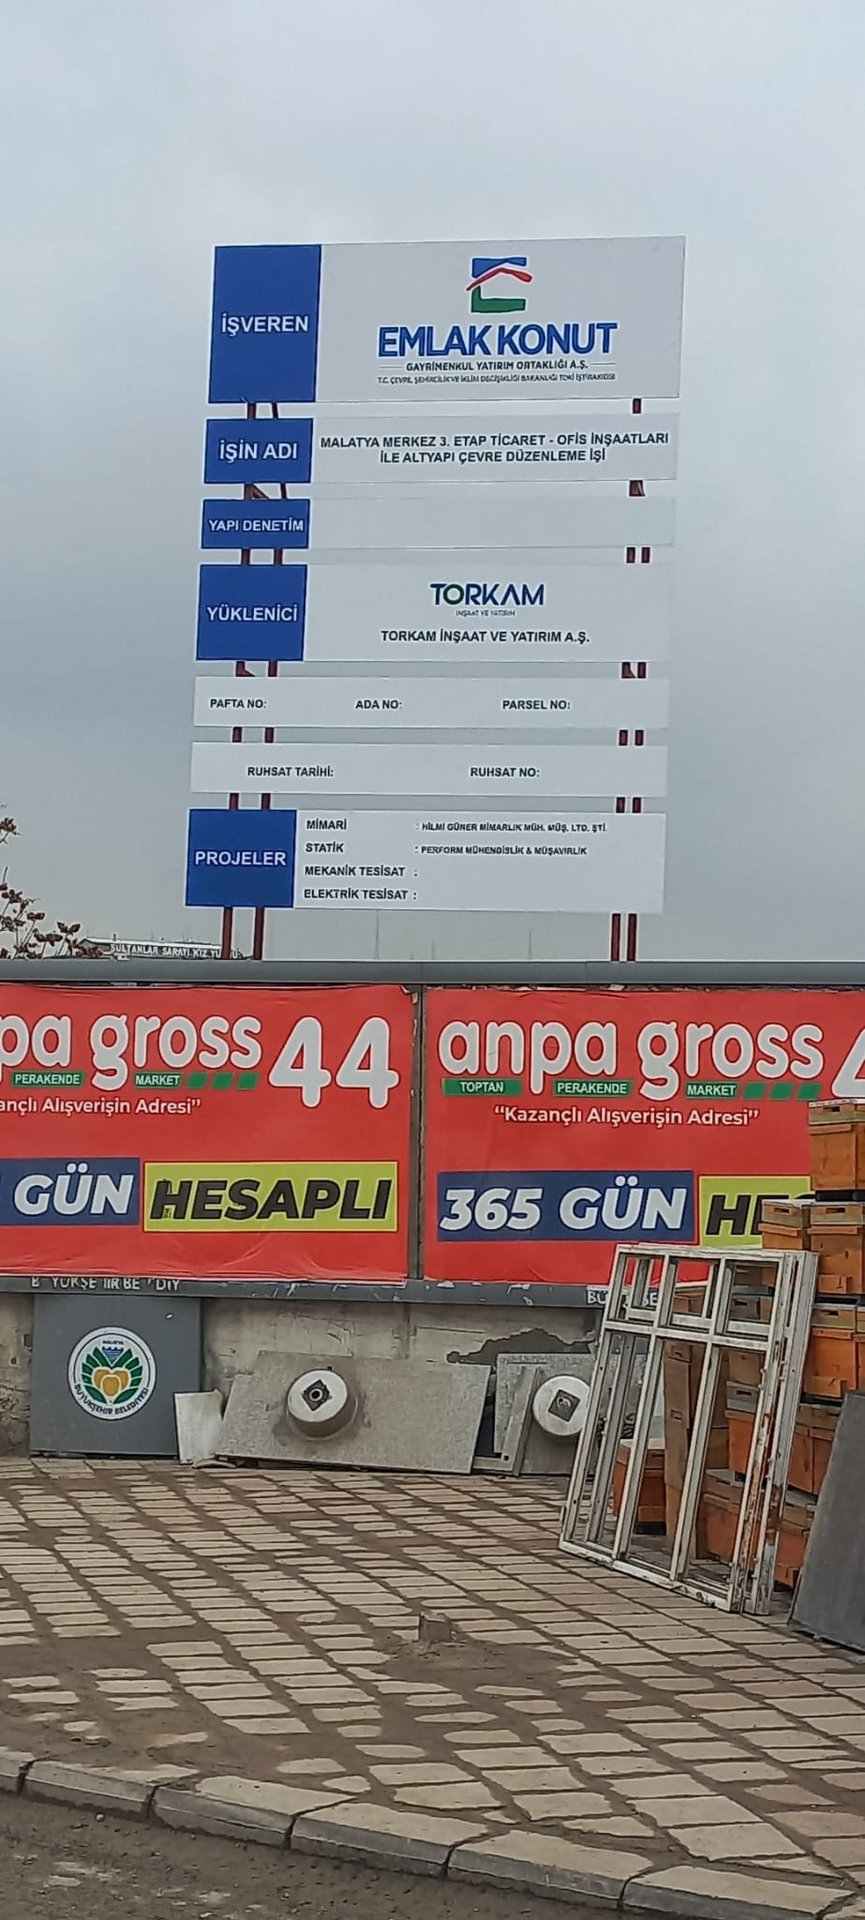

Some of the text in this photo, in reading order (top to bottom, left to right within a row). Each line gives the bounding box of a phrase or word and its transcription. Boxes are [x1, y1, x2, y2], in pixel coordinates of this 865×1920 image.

[221, 313, 308, 336] İŞVEREN
[378, 322, 618, 357] EMLAK KONUT
[406, 359, 588, 371] GAYRİMENKUL YATIRIM ORTAKLIĞI A.Ş.
[320, 437, 380, 448] MALATYA
[382, 436, 437, 447] MERKEZ
[439, 436, 450, 447] 3.
[453, 435, 487, 446] ETAP
[490, 433, 546, 446] TİCARET
[557, 432, 587, 445] OFİS
[590, 432, 669, 447] İNŞAATLARI
[220, 439, 298, 463] İŞİN ADI
[380, 448, 606, 464] İLE ALTYAPI ÇEVRE DÜZENLEME İŞİ
[208, 517, 304, 531] YAPI DENETİM
[430, 583, 544, 605] TORKAM
[207, 603, 298, 622] YÜKLENİCİ
[380, 629, 590, 644] TORKAM İNŞAAT VE YATIRIM A.Ş.
[210, 698, 267, 710] PAFTA NO:
[355, 700, 402, 710] ADA NO:
[502, 700, 570, 711] PARSEL NO:
[247, 765, 334, 777] RUHSAT TARİHİ:
[470, 767, 540, 778] RUHSAT NO:
[306, 818, 347, 830] MİMARİ
[446, 822, 478, 831] GÜNER
[479, 821, 522, 832] MİMARLIK
[523, 822, 546, 832] MÜH.
[571, 823, 590, 832] LTD.
[305, 841, 344, 853] STATİK
[420, 845, 464, 854] PERFORM
[465, 844, 524, 855] MÜHENDİSLİK
[525, 846, 532, 855] &
[194, 851, 287, 867] PROJELER
[304, 864, 356, 876] MEKANİK
[359, 864, 405, 877] TESİSAT
[304, 887, 359, 899] ELEKTRİK
[361, 887, 408, 900] TESİSAT
[90, 1014, 262, 1090] gross
[268, 1016, 400, 1109] 44
[438, 1020, 617, 1095] anpa
[636, 1021, 825, 1101] gross
[14, 1073, 181, 1087] PERAKENDE MARKET
[459, 1081, 737, 1097] TOPTAN PERAKENDE MARKET
[42, 1096, 131, 1118] Alışverişin
[586, 1106, 683, 1129] Alışverişin
[13, 1162, 136, 1216] GÜN
[148, 1179, 393, 1221] HESAPLI
[438, 1175, 687, 1231] 365 GÜN
